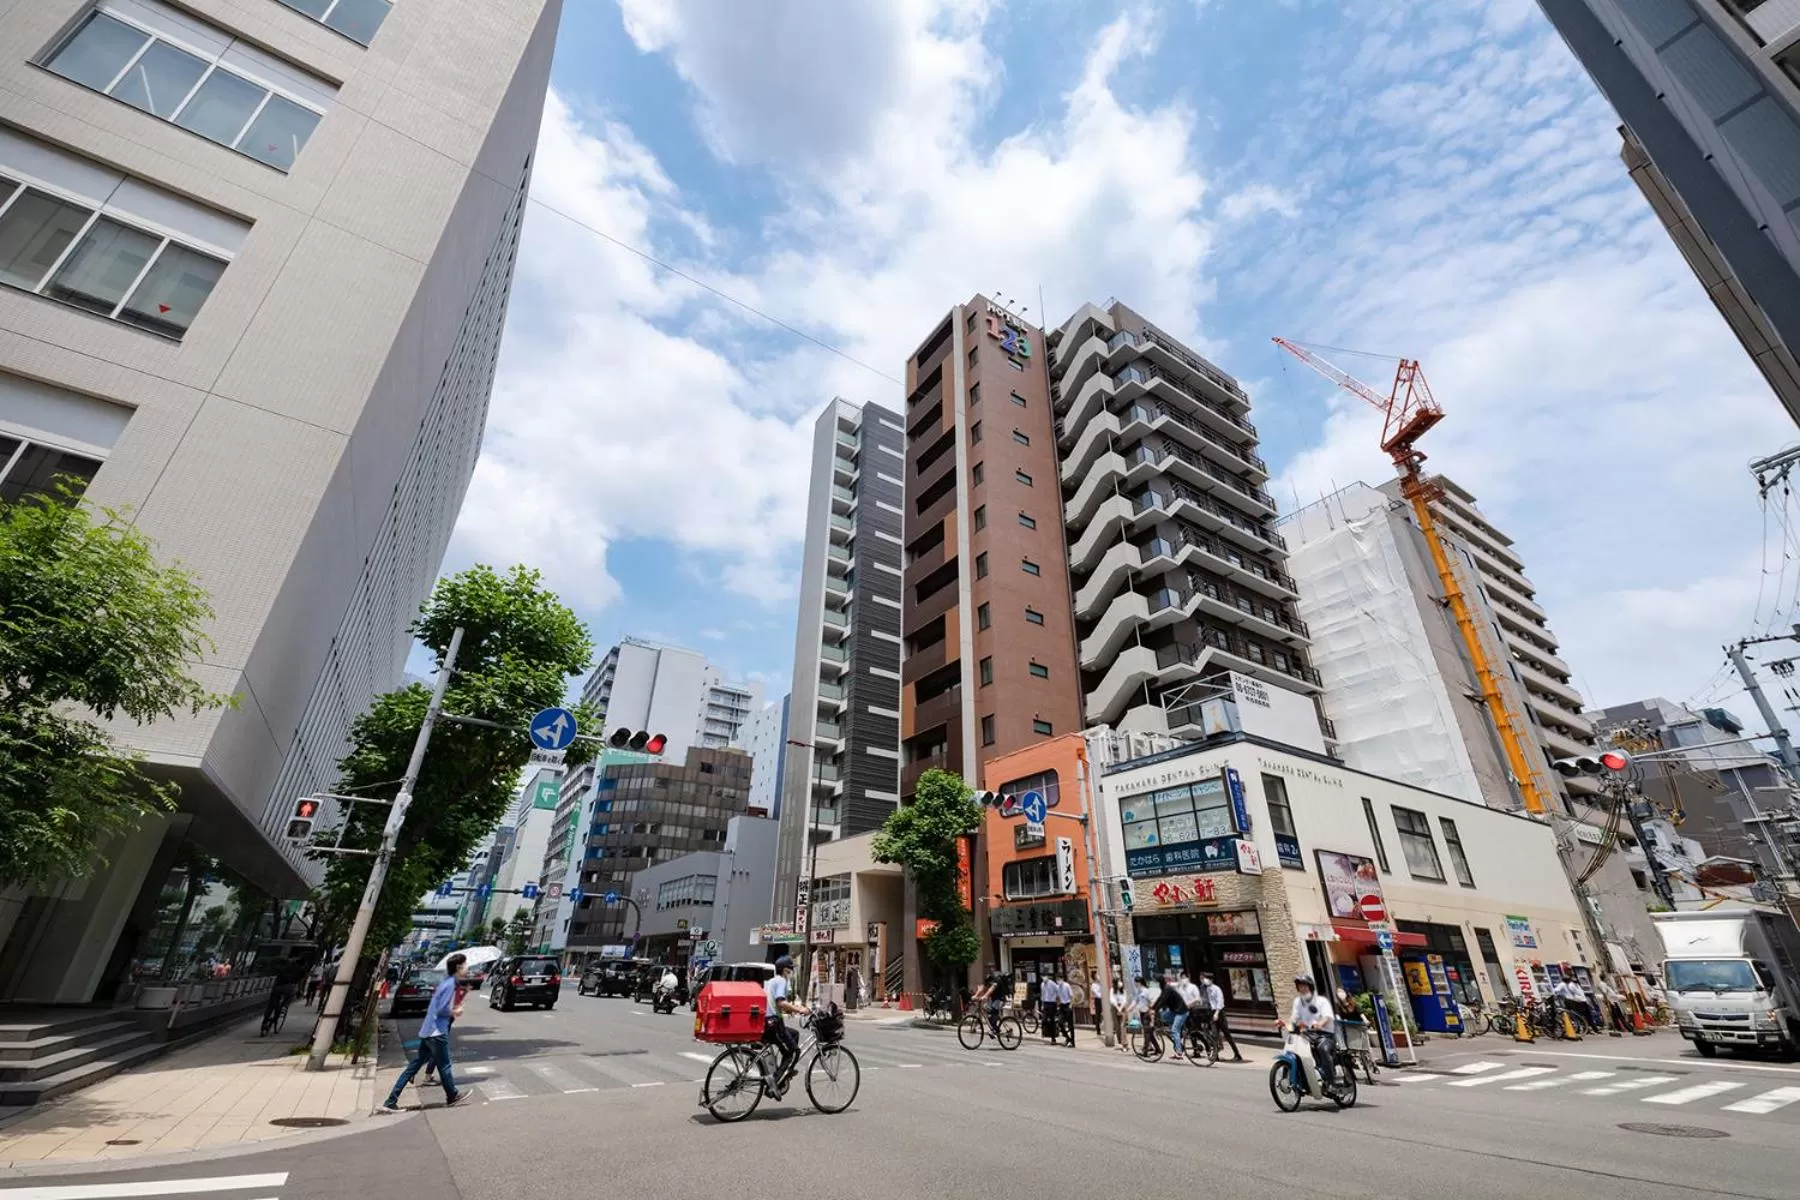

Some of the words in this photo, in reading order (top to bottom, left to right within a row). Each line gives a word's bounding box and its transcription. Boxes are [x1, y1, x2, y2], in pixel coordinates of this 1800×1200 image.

[1115, 777, 1157, 793] TAKAHARA
[1161, 768, 1195, 784] DENTAL
[1199, 760, 1230, 774] CLINIC
[1258, 757, 1294, 775] TAKAHARA
[1296, 768, 1321, 782] DENTAL
[1061, 840, 1073, 890] ラーメン
[1130, 853, 1160, 867] たかはら
[1165, 848, 1200, 862] 歯科医院
[1153, 879, 1216, 904] やよい軒
